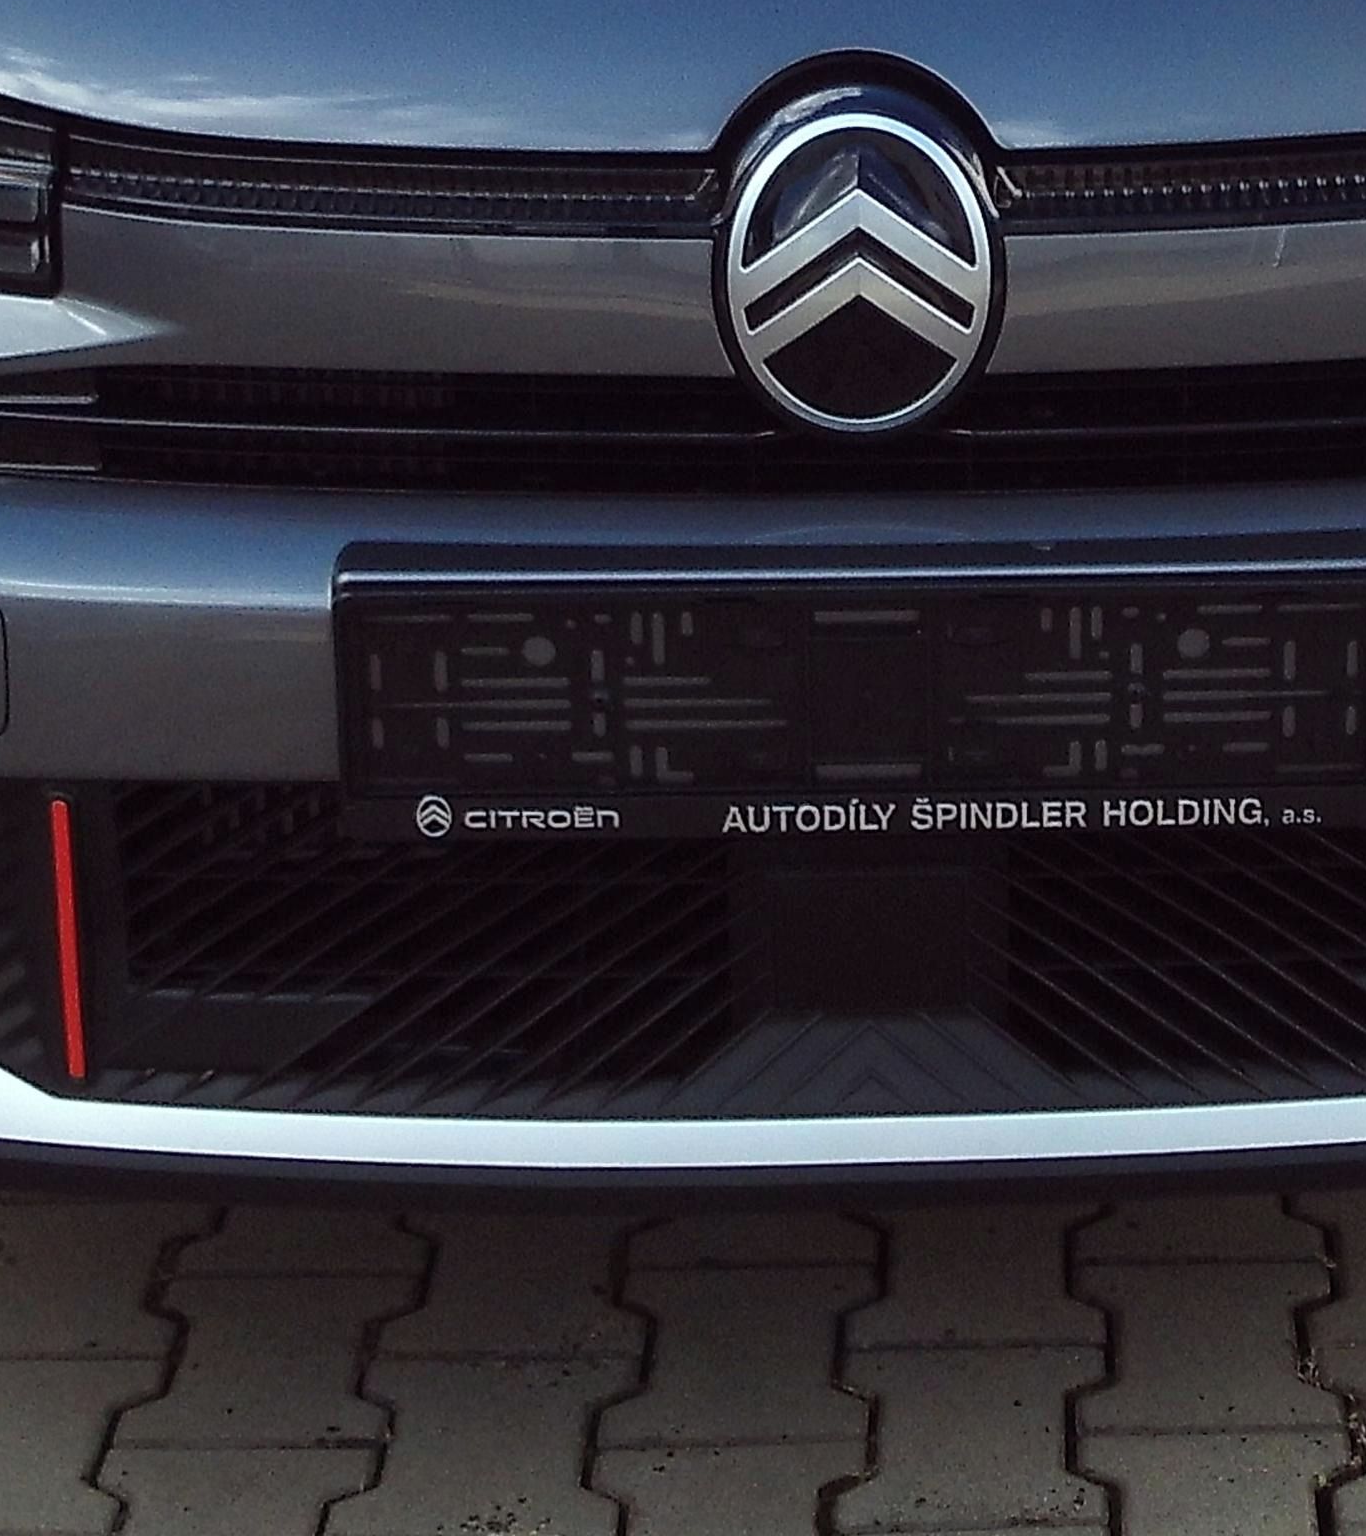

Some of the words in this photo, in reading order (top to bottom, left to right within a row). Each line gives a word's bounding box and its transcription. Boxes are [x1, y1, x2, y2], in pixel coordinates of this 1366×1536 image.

[464, 806, 620, 829] CITROËN
[722, 798, 896, 833] AUTODÍLY
[910, 797, 1087, 830] ŠPINDLER
[1103, 797, 1270, 827] HOLDING,
[1281, 808, 1322, 824] a.s.
